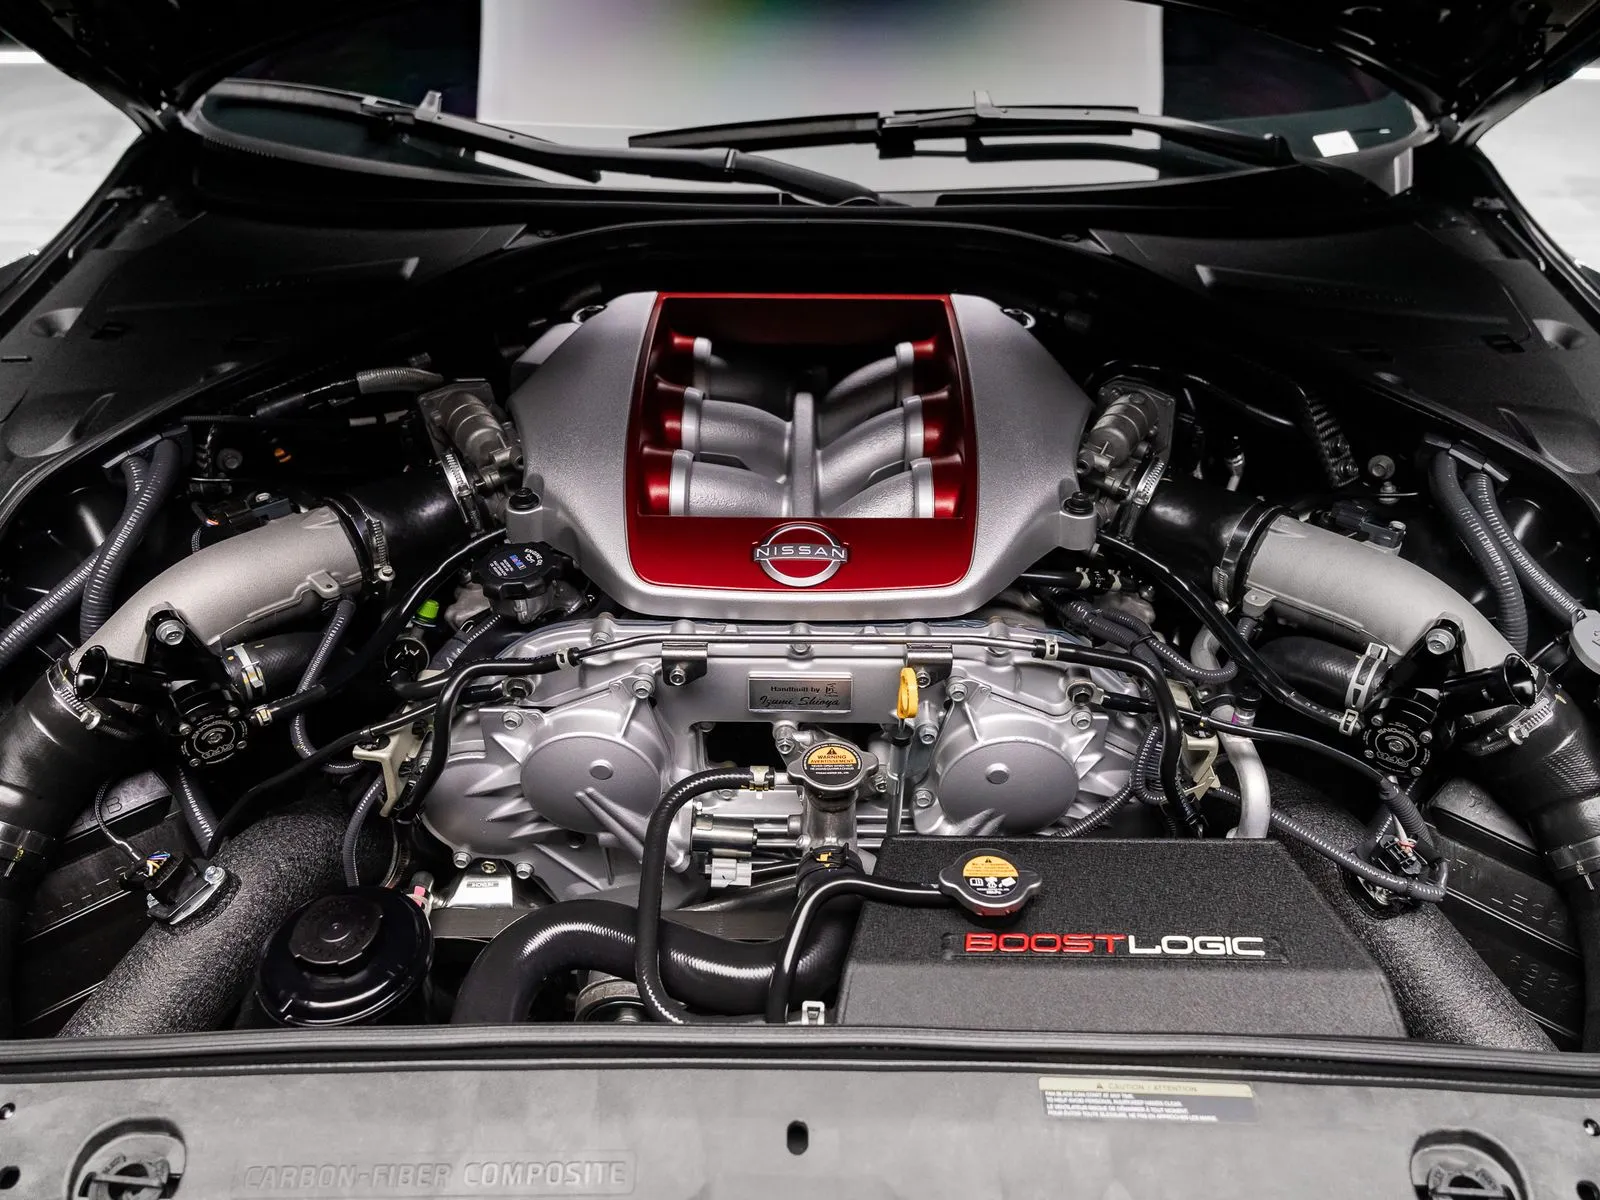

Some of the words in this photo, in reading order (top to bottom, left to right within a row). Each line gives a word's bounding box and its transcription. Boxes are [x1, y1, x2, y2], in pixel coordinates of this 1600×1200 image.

[756, 545, 845, 559] NISSAN
[810, 686, 821, 694] by
[759, 695, 793, 708] Izumi
[1108, 1082, 1145, 1090] CAUTION
[1153, 1084, 1198, 1092] ATTENTION
[243, 1162, 453, 1190] CARBON-FIBER
[463, 1160, 628, 1187] COMPOSITE
